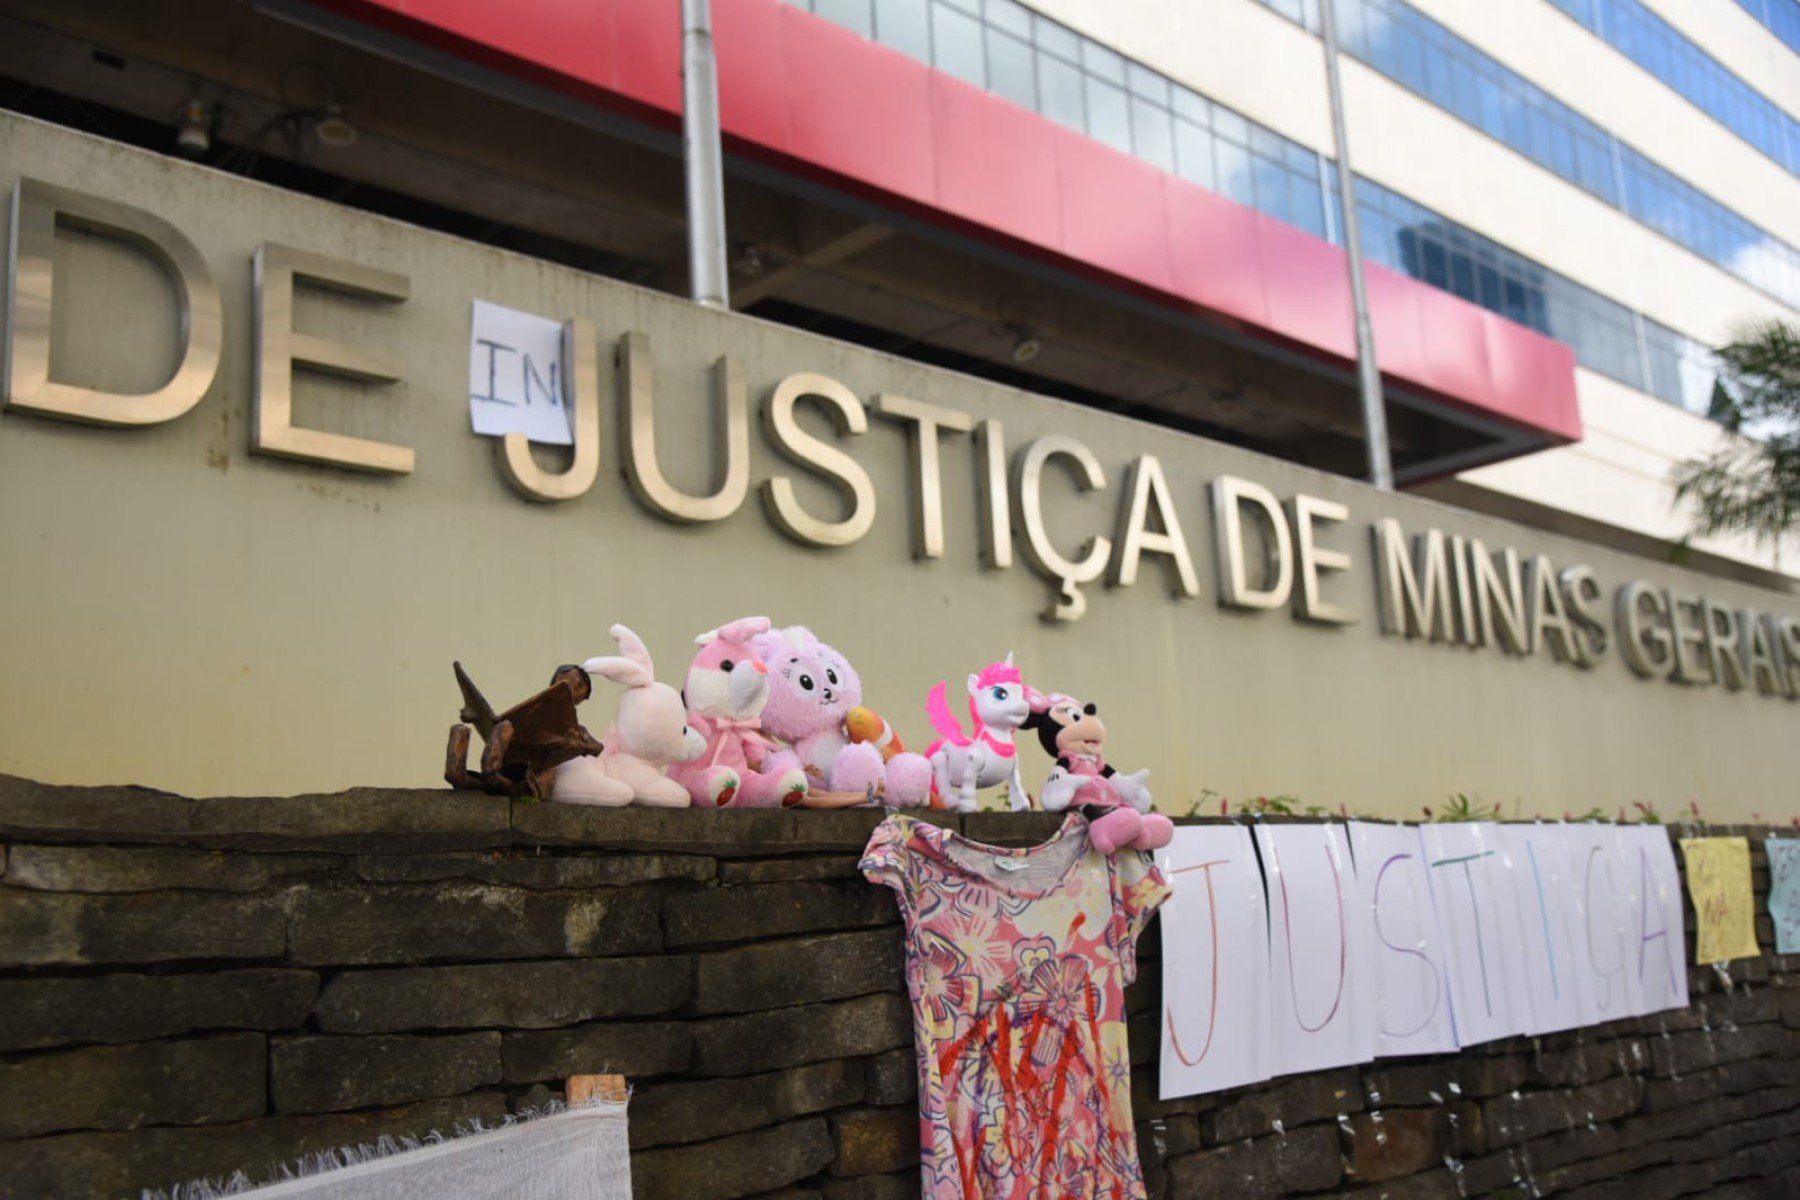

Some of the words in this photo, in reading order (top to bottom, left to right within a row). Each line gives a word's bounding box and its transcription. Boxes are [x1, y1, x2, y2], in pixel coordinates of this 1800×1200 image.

[4, 176, 416, 475] DE
[503, 316, 1198, 621] JUSTIÇA
[1213, 474, 1360, 625] DE
[1376, 518, 1610, 668] MINAS
[470, 338, 559, 407] IN
